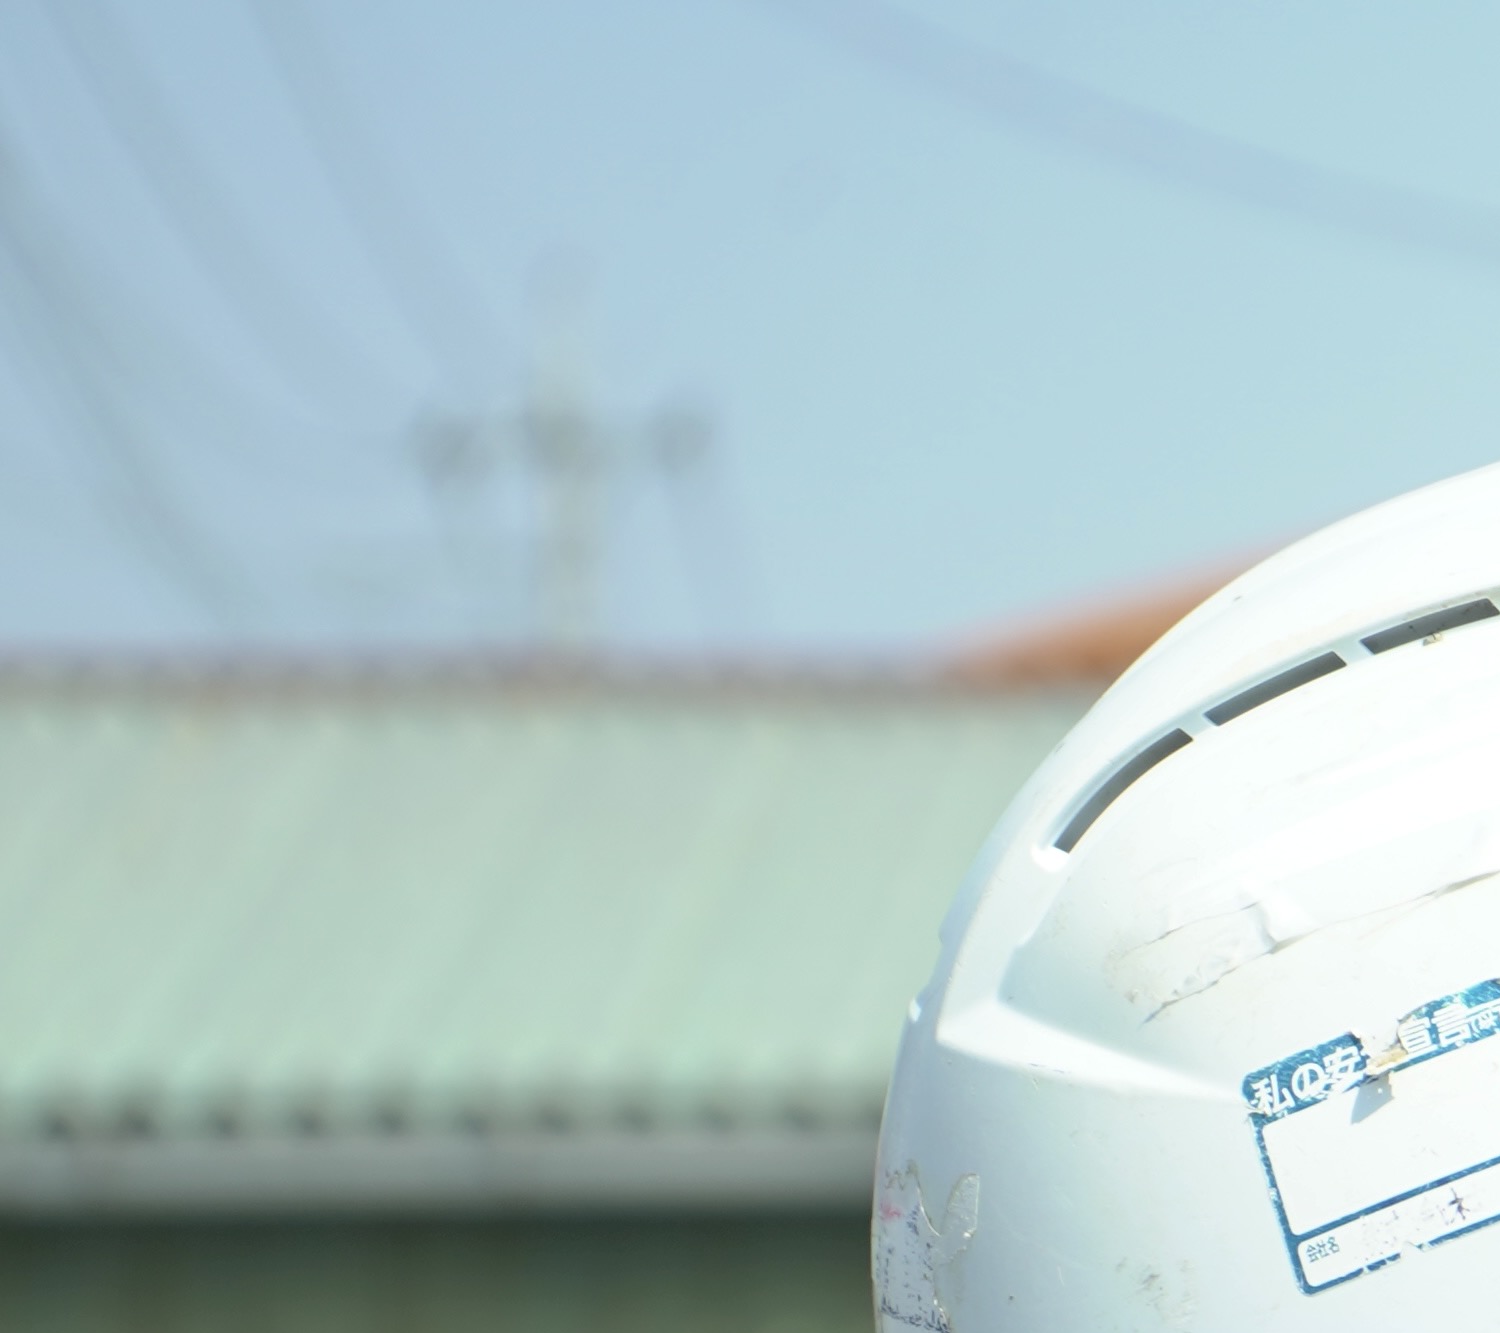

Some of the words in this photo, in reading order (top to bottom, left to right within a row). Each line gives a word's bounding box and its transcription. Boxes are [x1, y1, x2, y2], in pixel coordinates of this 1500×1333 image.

[1251, 1003, 1471, 1116] 私の安宣言
